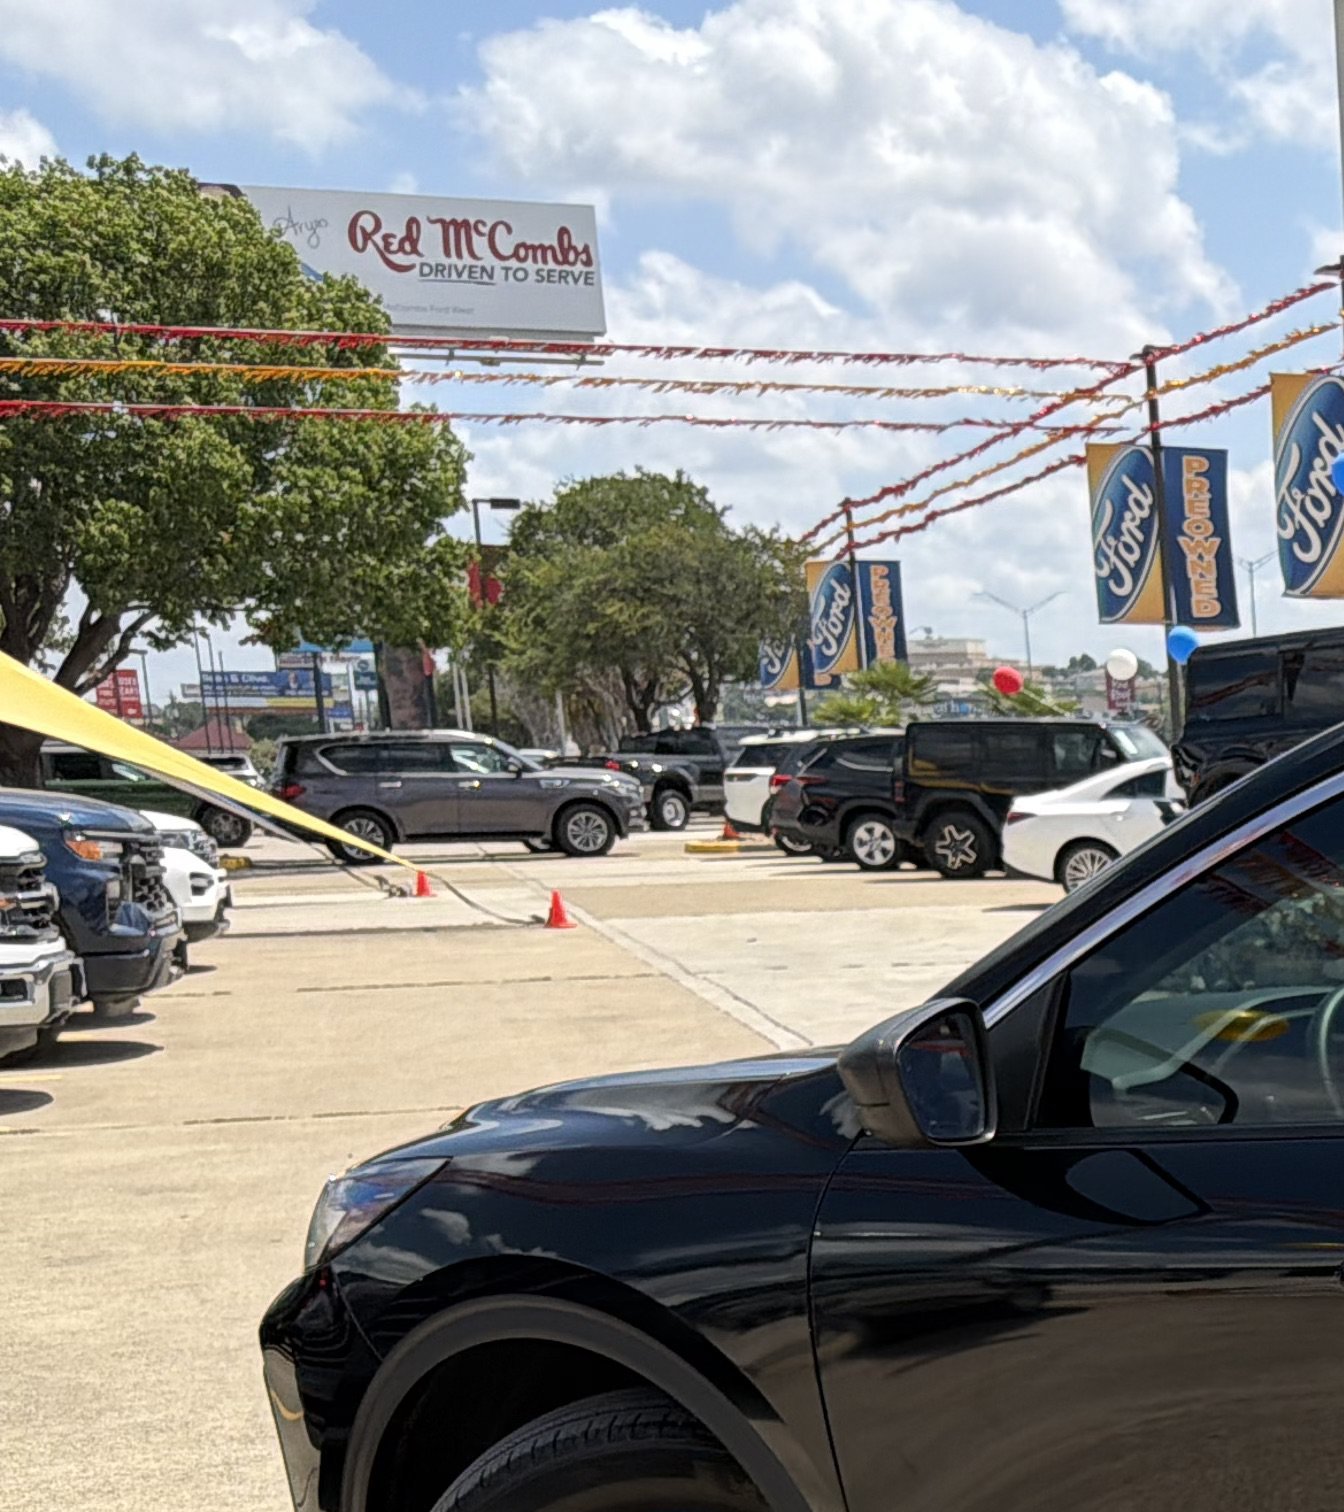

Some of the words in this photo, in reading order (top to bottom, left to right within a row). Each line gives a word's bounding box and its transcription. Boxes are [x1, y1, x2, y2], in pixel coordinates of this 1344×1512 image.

[348, 209, 424, 273] Red
[426, 215, 593, 268] McCombs
[419, 262, 495, 280] DRIVEN
[501, 266, 529, 282] TO
[535, 269, 596, 286] SERVE
[1096, 474, 1153, 597] Ford
[1176, 455, 1222, 618] PREOWNED
[810, 578, 851, 656] Ford
